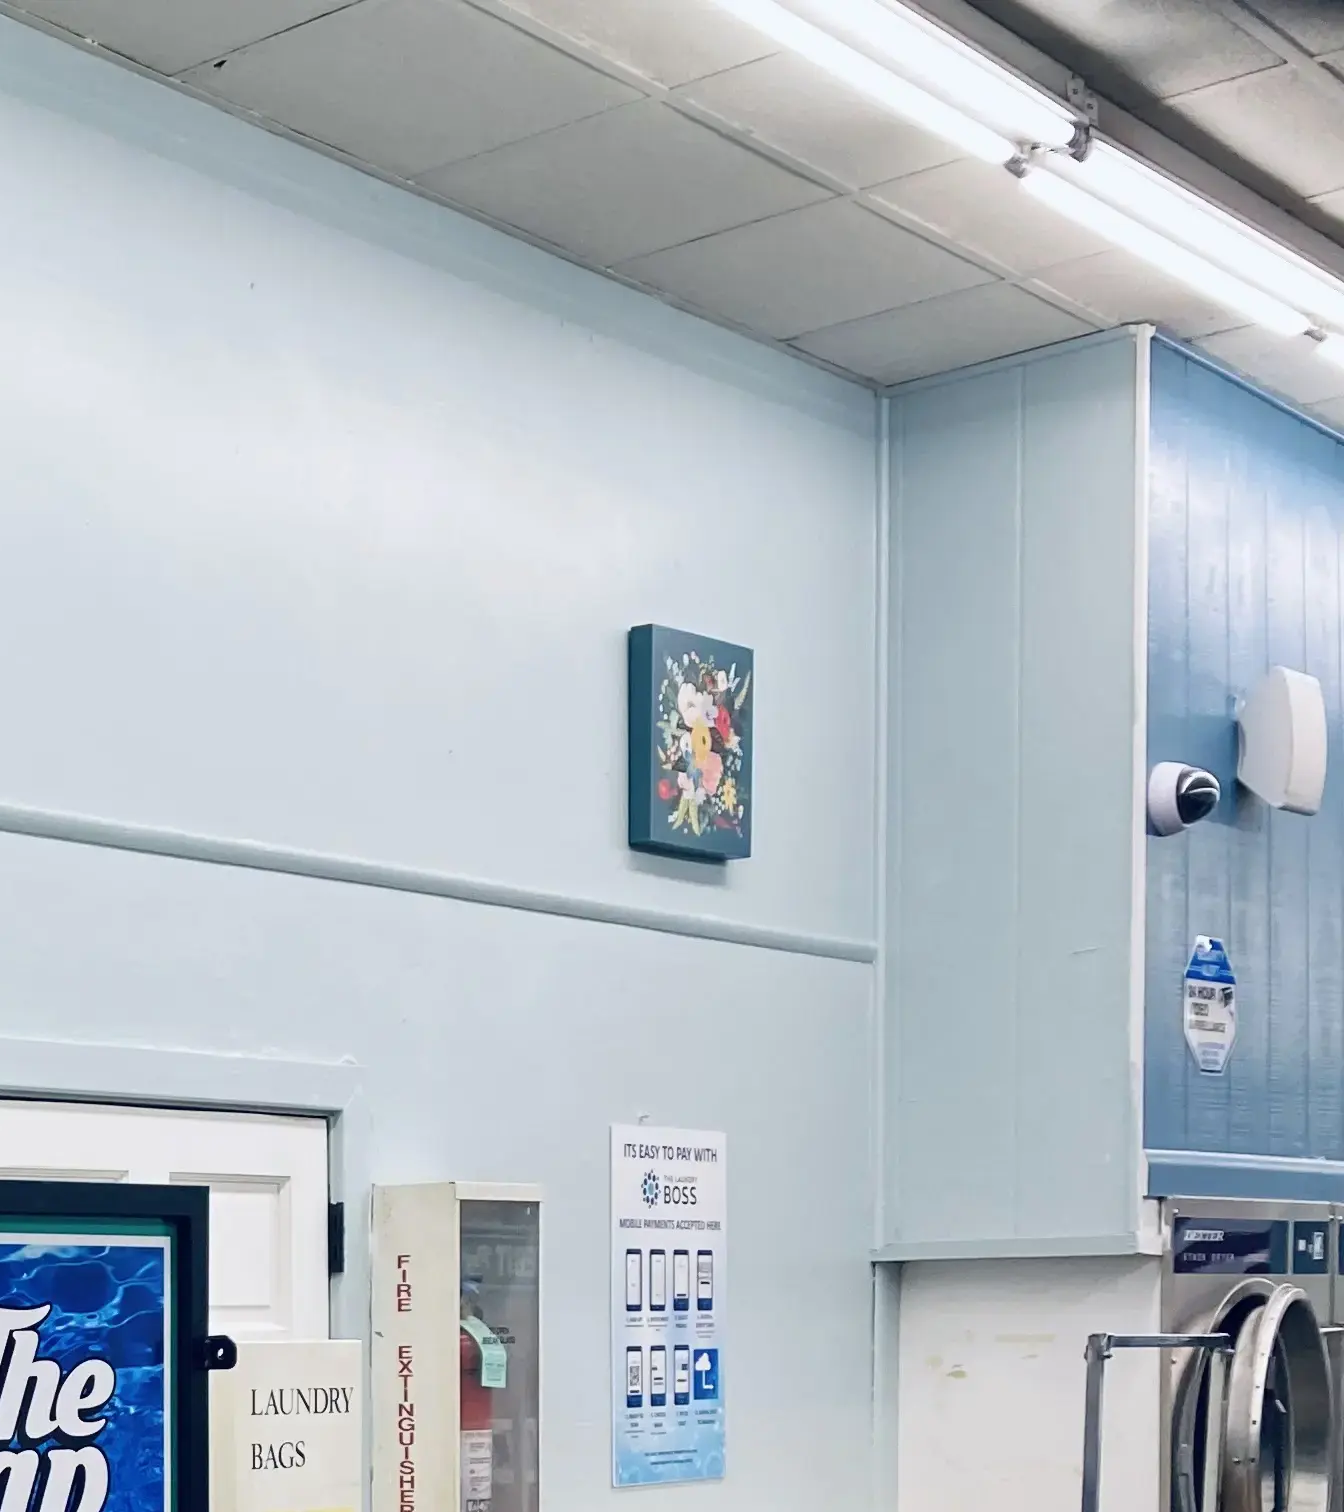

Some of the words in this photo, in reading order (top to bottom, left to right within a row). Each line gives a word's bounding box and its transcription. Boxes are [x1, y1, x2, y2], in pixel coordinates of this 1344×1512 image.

[624, 1143, 637, 1158] ITS
[639, 1144, 660, 1159] EASY
[662, 1145, 674, 1160] TO
[676, 1146, 692, 1160] PAY
[694, 1148, 717, 1162] WITH
[664, 1185, 697, 1205] BOSS
[644, 1219, 674, 1230] PAYMENTS
[676, 1220, 705, 1231] ACCEPTED
[397, 1254, 412, 1312] FIRE
[251, 1386, 354, 1416] LAUNDRY
[251, 1440, 306, 1470] BAGS
